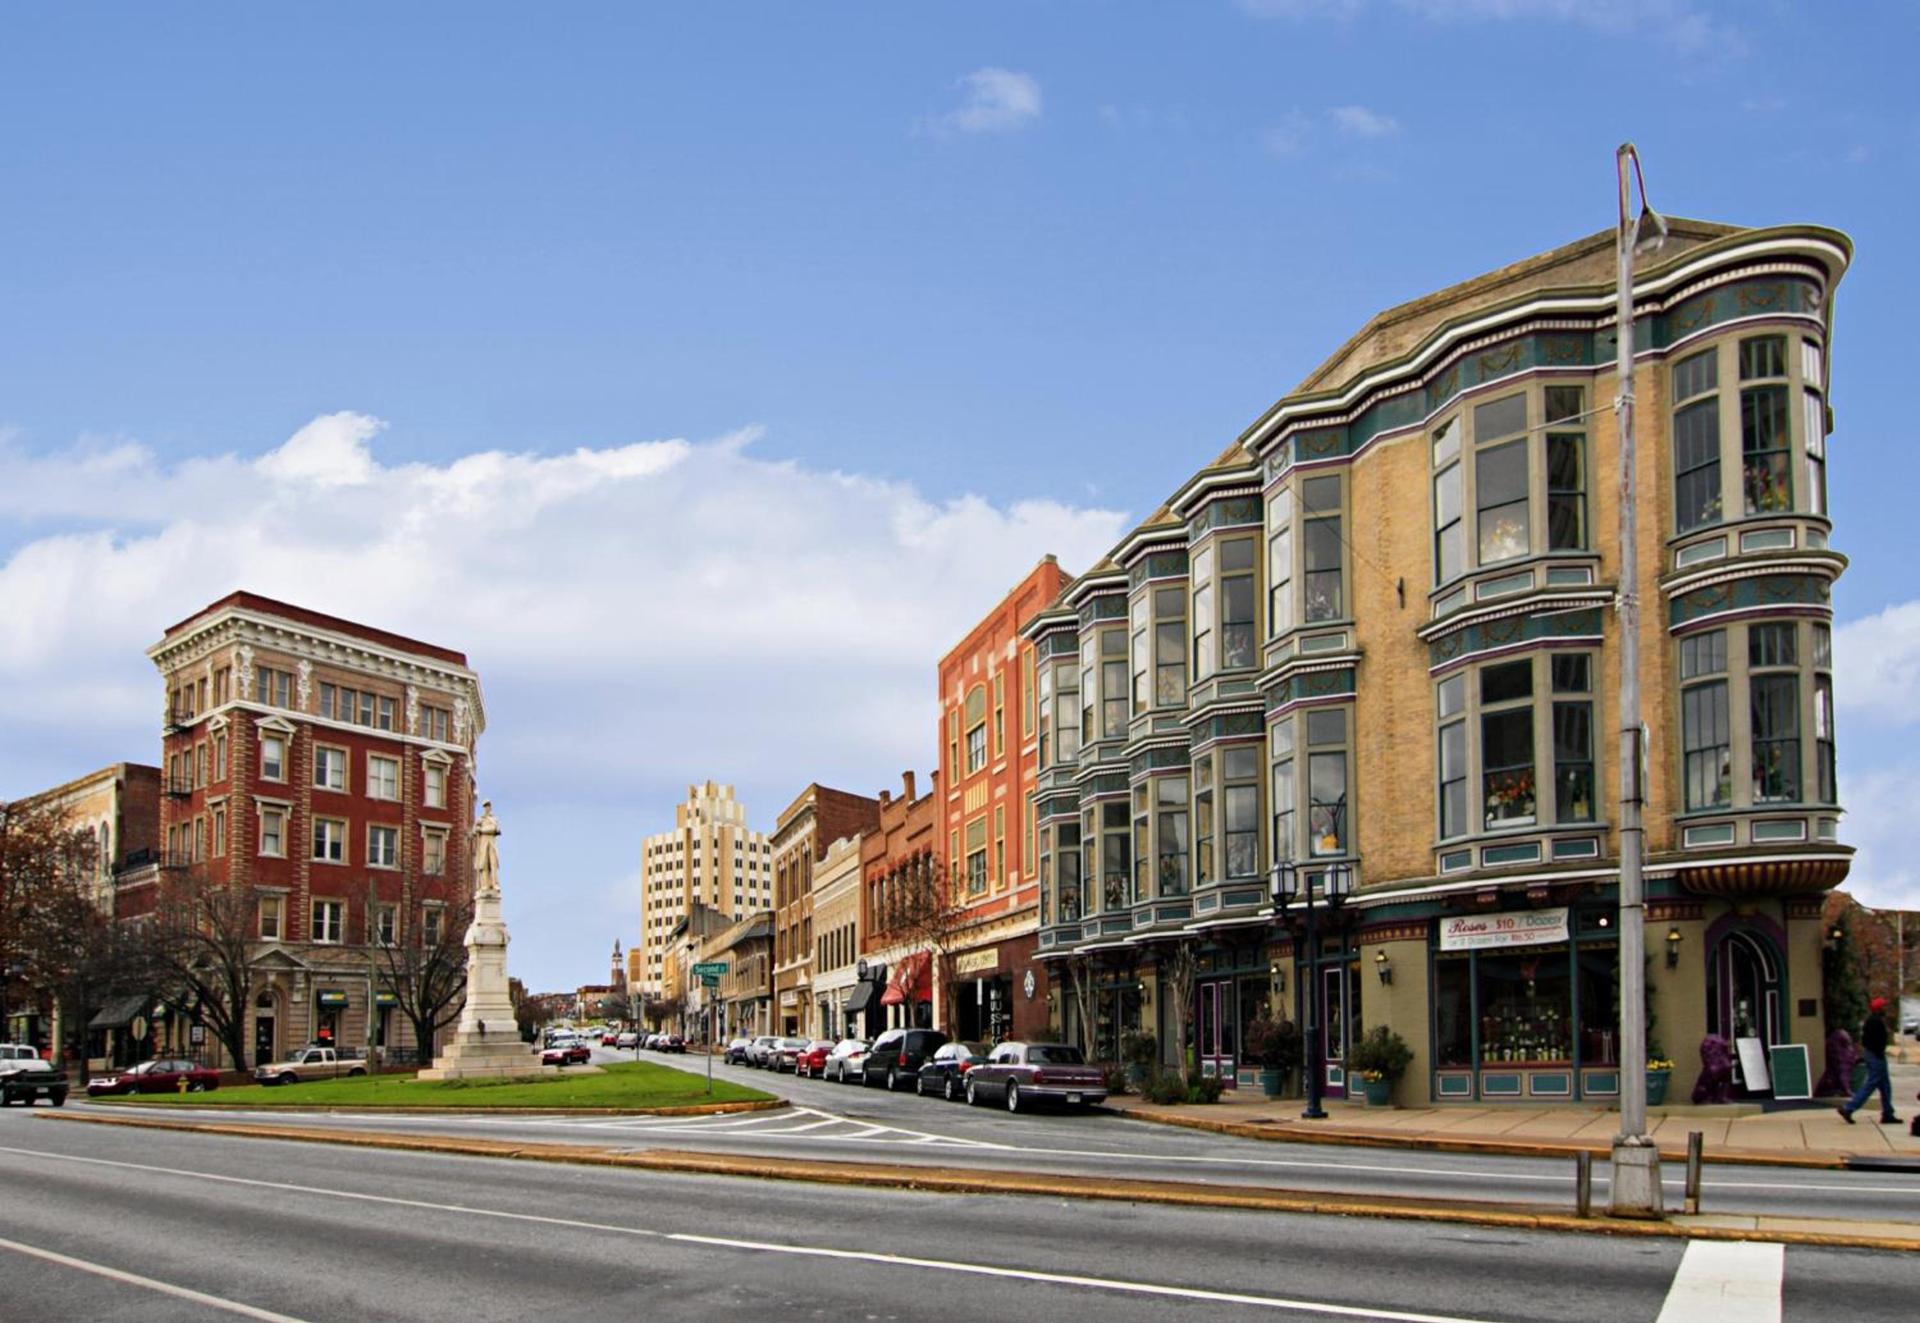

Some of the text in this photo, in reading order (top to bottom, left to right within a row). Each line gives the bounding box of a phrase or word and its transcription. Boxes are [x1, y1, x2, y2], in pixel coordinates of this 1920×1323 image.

[1448, 919, 1488, 933] Roses
[1496, 918, 1514, 930] $10
[1527, 915, 1561, 925] Dozen
